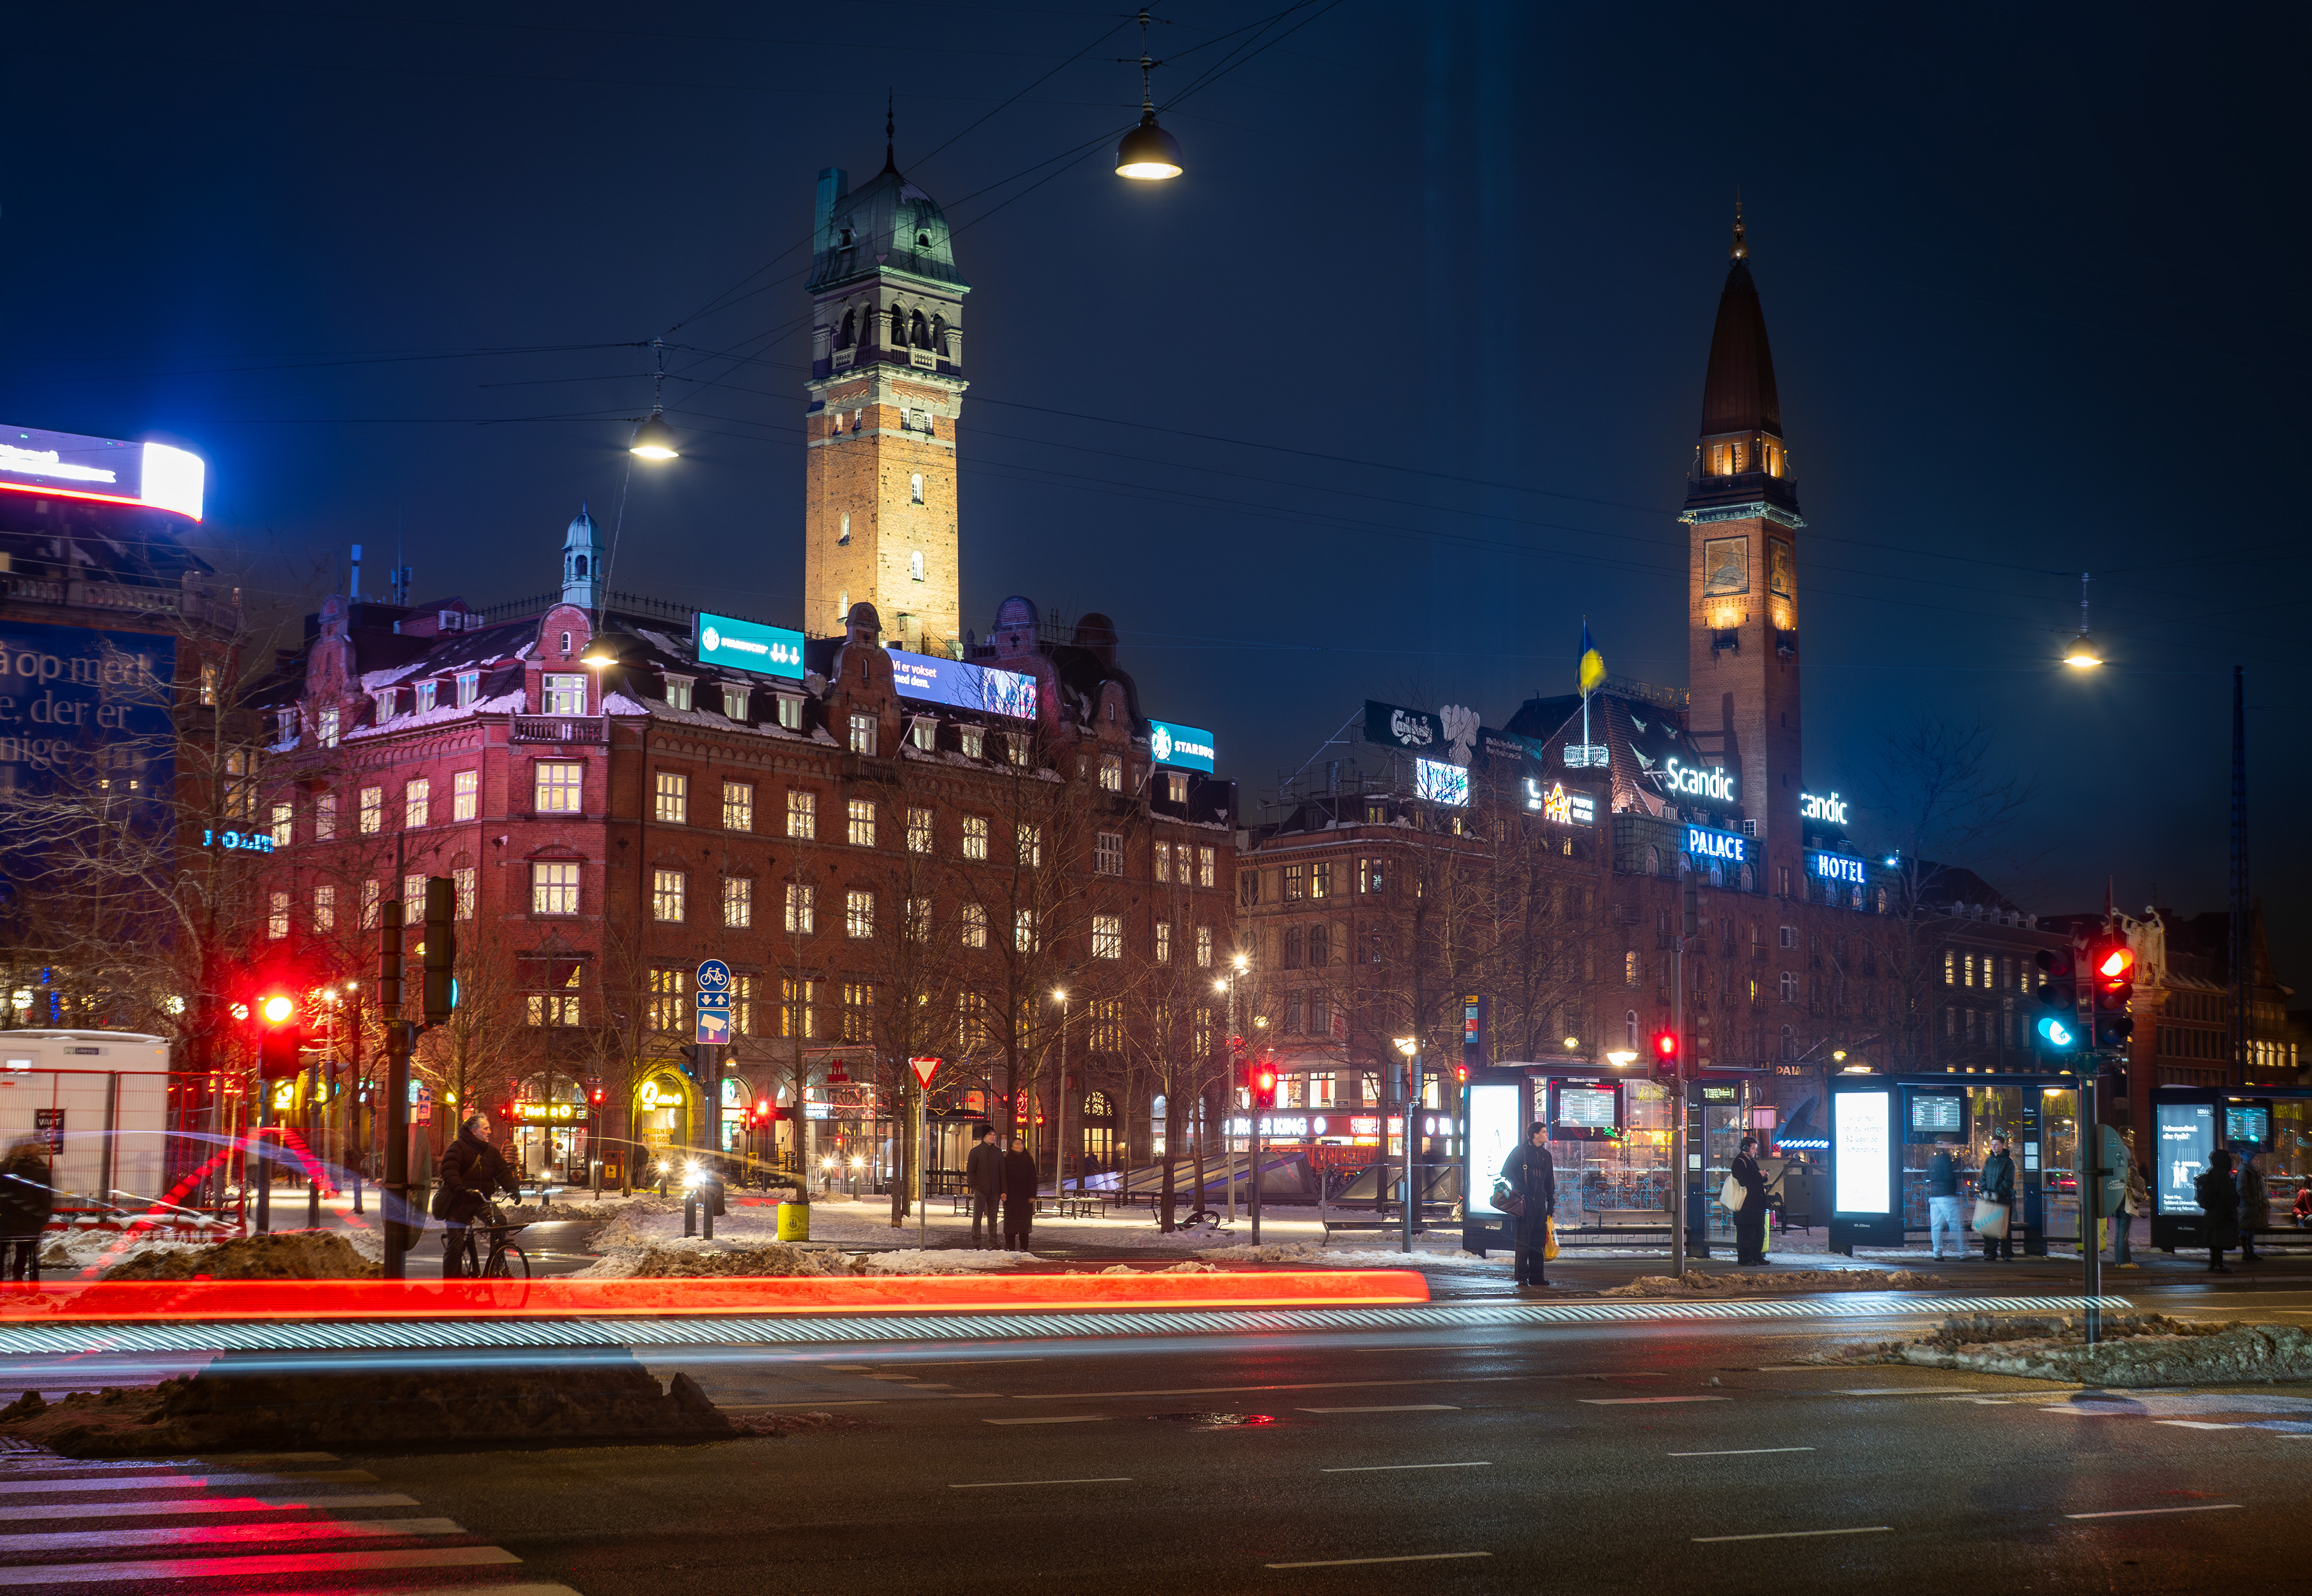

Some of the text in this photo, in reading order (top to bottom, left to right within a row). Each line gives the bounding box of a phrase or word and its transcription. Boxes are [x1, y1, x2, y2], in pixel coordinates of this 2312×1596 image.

[16, 653, 61, 685] op
[71, 654, 150, 686] med
[892, 660, 937, 678] Vi er vokset
[910, 675, 930, 688] dem.
[30, 690, 91, 726] der
[96, 704, 133, 729] er
[1667, 758, 1734, 801] Scandic
[1689, 830, 1744, 861] PALACE
[1818, 855, 1865, 883] HOTEL
[524, 1106, 559, 1116] Neto
[1273, 1117, 1308, 1135] KING
